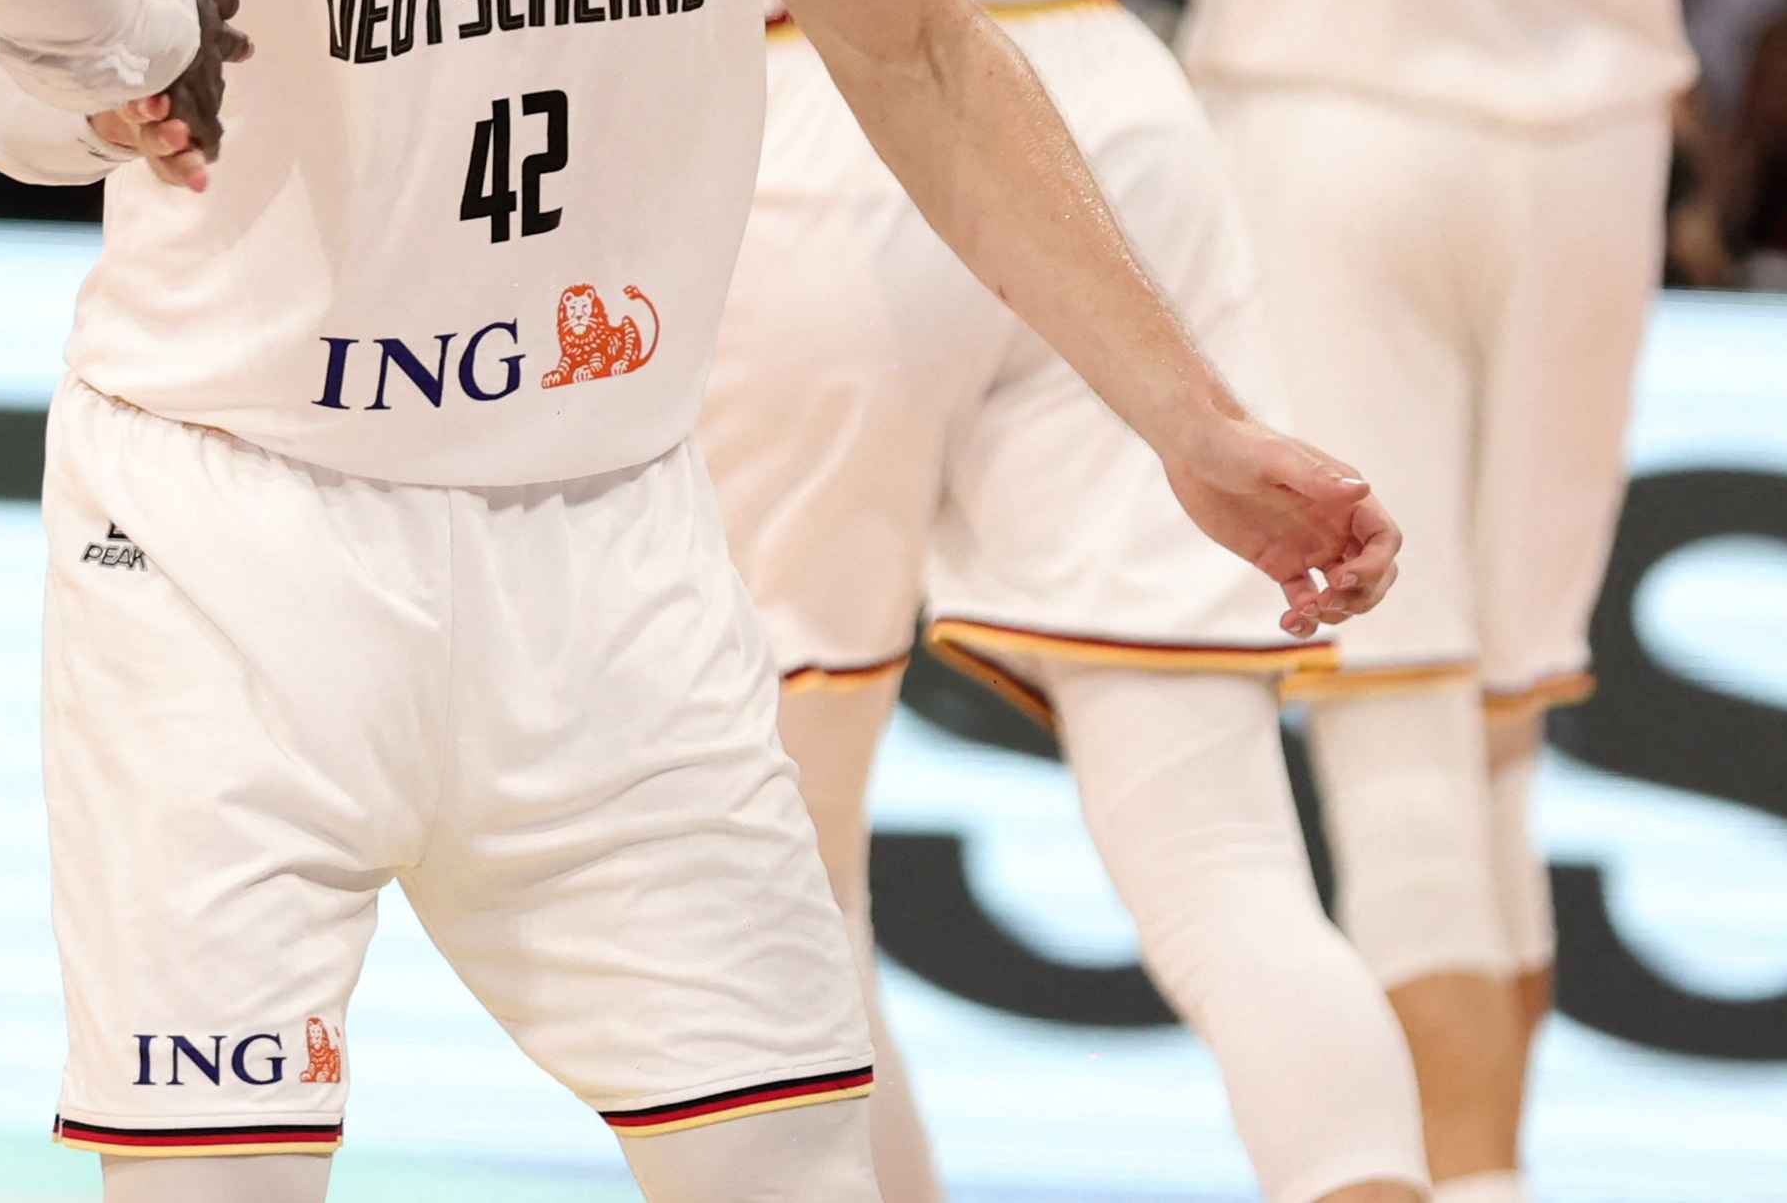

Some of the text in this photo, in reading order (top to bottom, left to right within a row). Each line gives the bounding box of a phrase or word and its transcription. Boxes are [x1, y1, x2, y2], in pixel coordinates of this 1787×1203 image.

[459, 89, 569, 245] 42
[311, 317, 527, 412] ING
[80, 542, 148, 571] PEAK
[132, 1032, 287, 1087] ING
